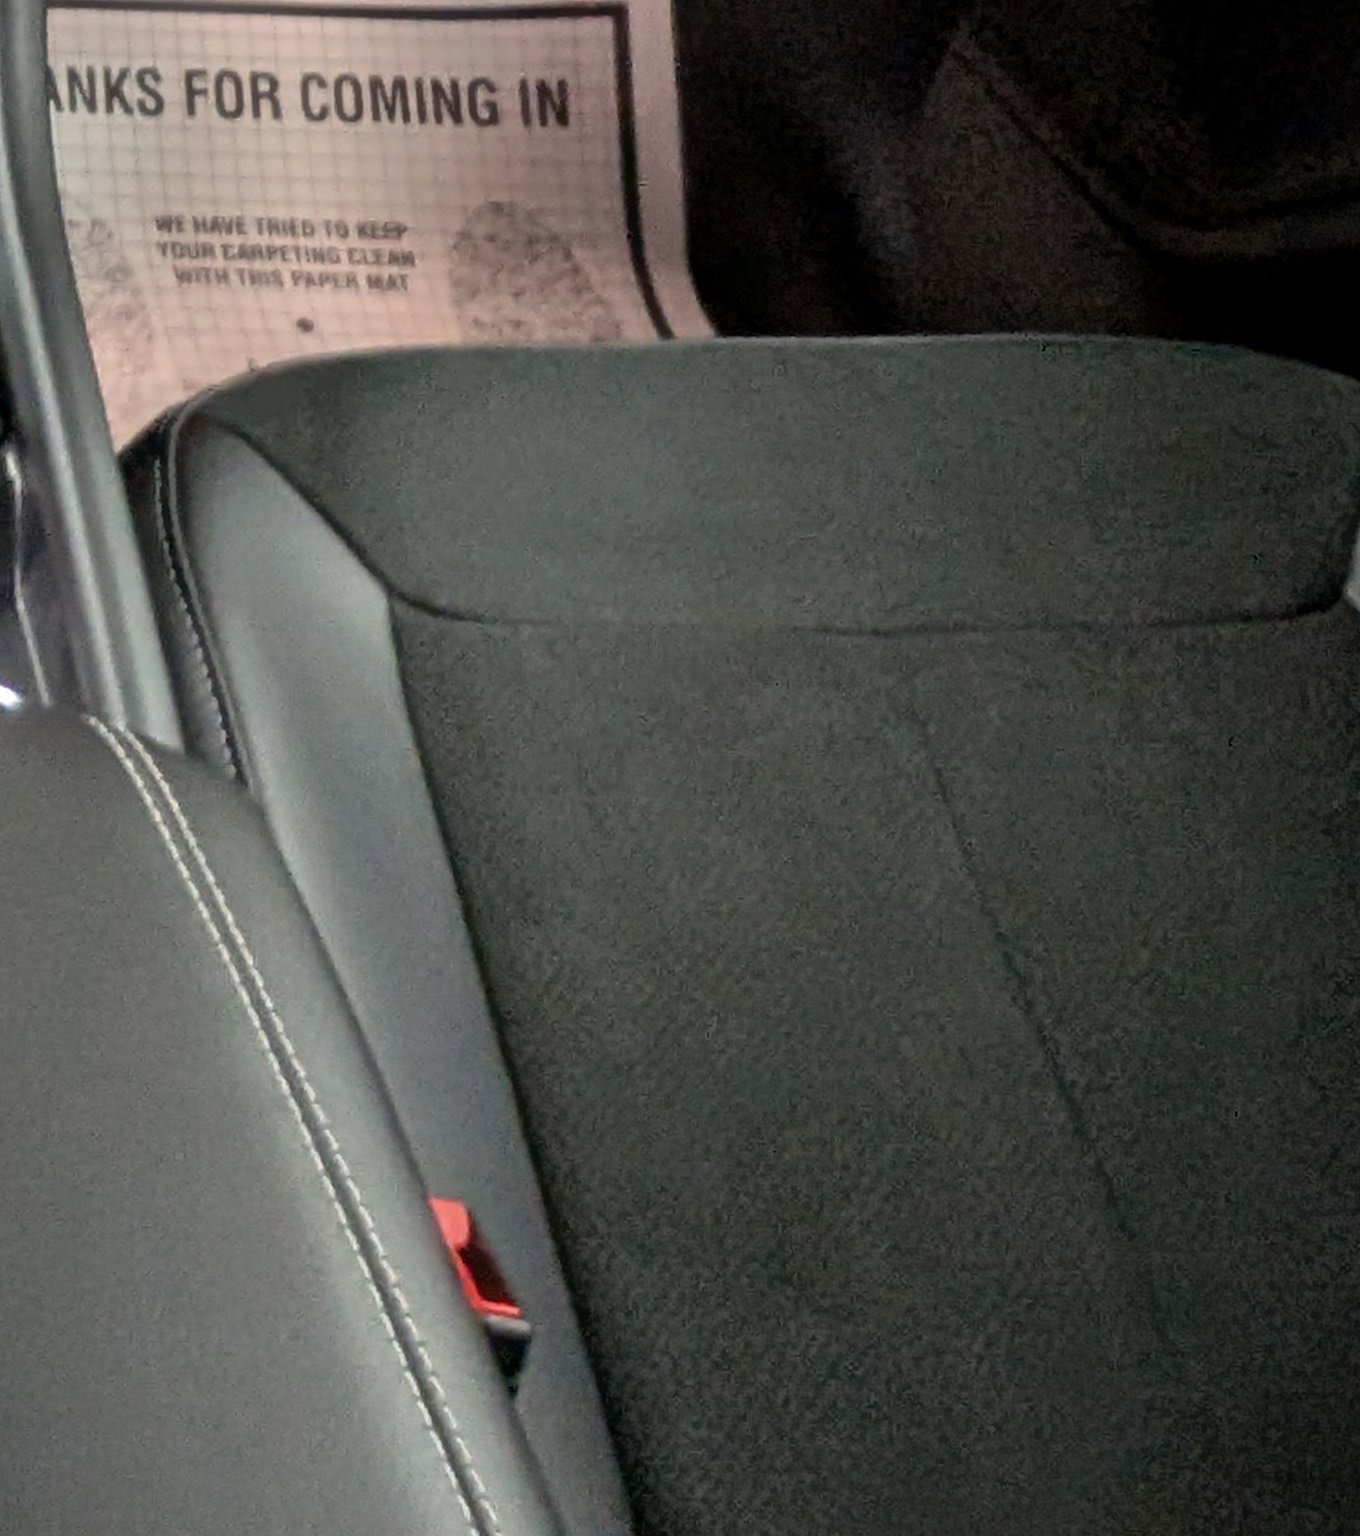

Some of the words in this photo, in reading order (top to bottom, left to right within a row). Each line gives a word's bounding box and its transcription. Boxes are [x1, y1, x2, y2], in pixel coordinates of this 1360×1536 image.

[46, 66, 164, 117] ANKS
[183, 68, 284, 120] FOR
[300, 70, 500, 126] COMING
[518, 77, 570, 127] IN
[192, 215, 247, 235] HAVE
[255, 216, 315, 237] TRIED
[323, 219, 350, 239] TO
[356, 219, 409, 241] KEEP
[156, 240, 216, 260] YOUR
[220, 242, 342, 264] CARPETING
[347, 246, 416, 267] CLEAN
[174, 266, 230, 286] WITH
[234, 267, 284, 288] THIS
[290, 269, 360, 290] PAPER
[365, 272, 410, 292] MAT
